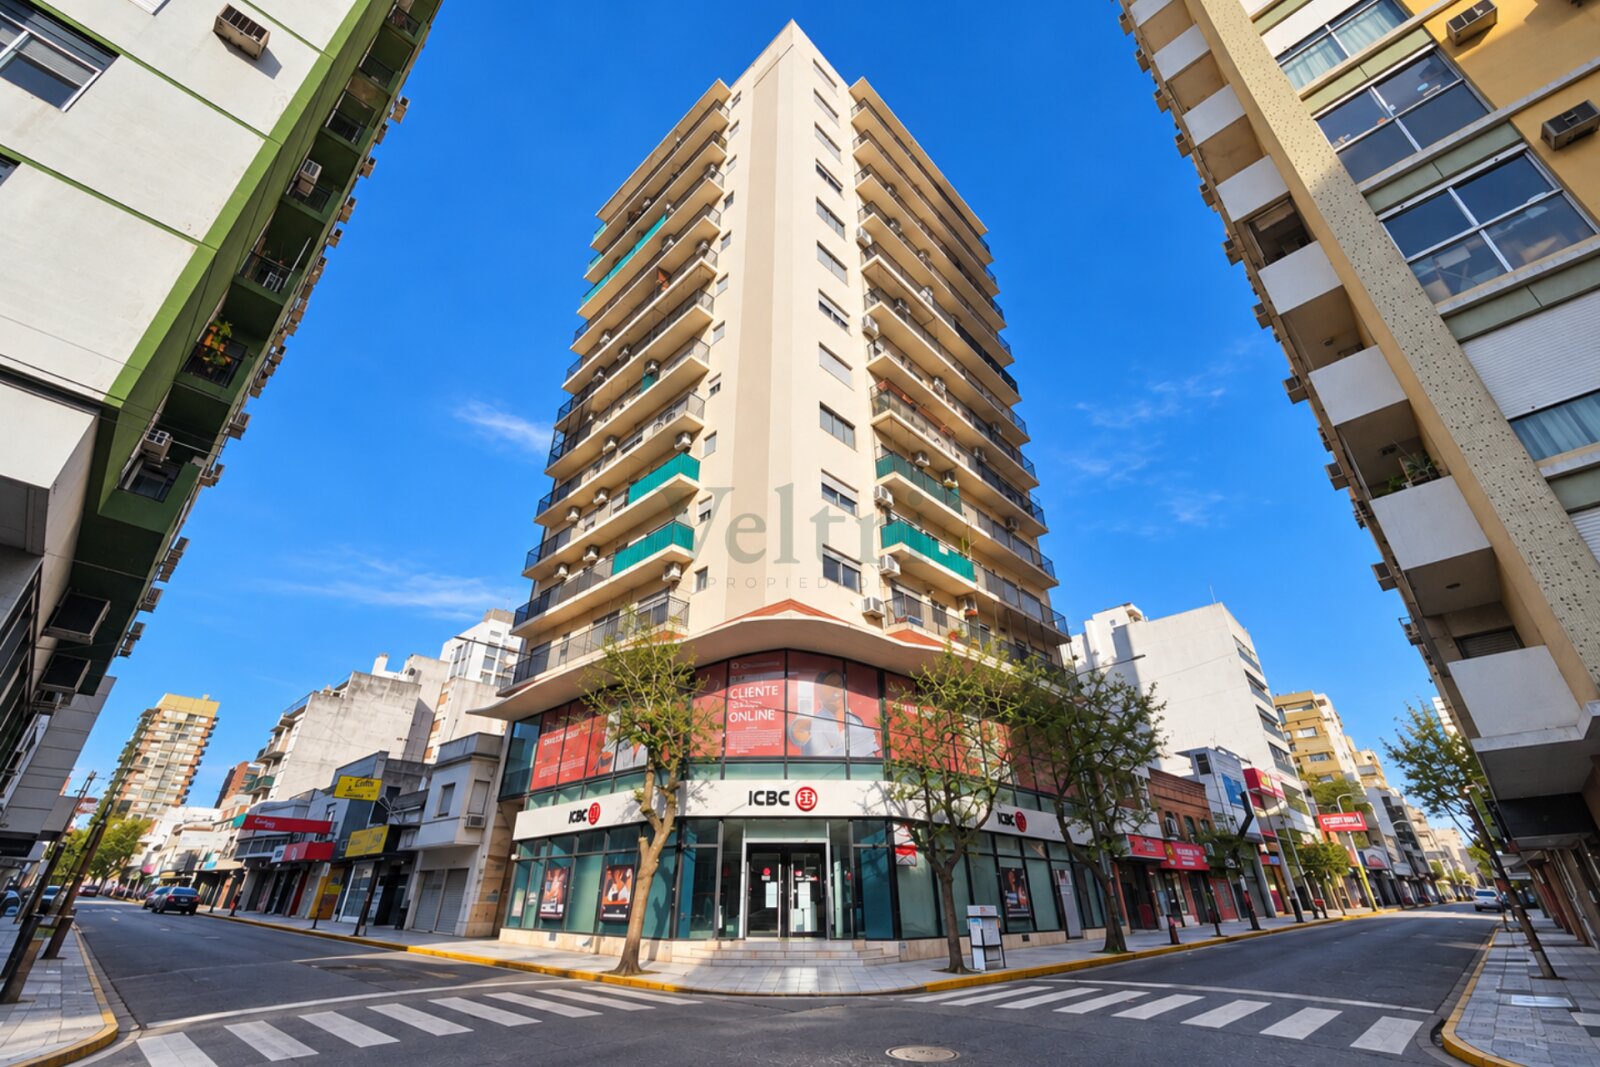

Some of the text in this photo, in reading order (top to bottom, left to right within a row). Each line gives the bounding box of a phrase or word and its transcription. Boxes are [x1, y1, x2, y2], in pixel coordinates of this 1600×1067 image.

[730, 685, 779, 699] CLIENTE
[729, 709, 775, 723] ONLINE
[748, 790, 790, 806] ICBC
